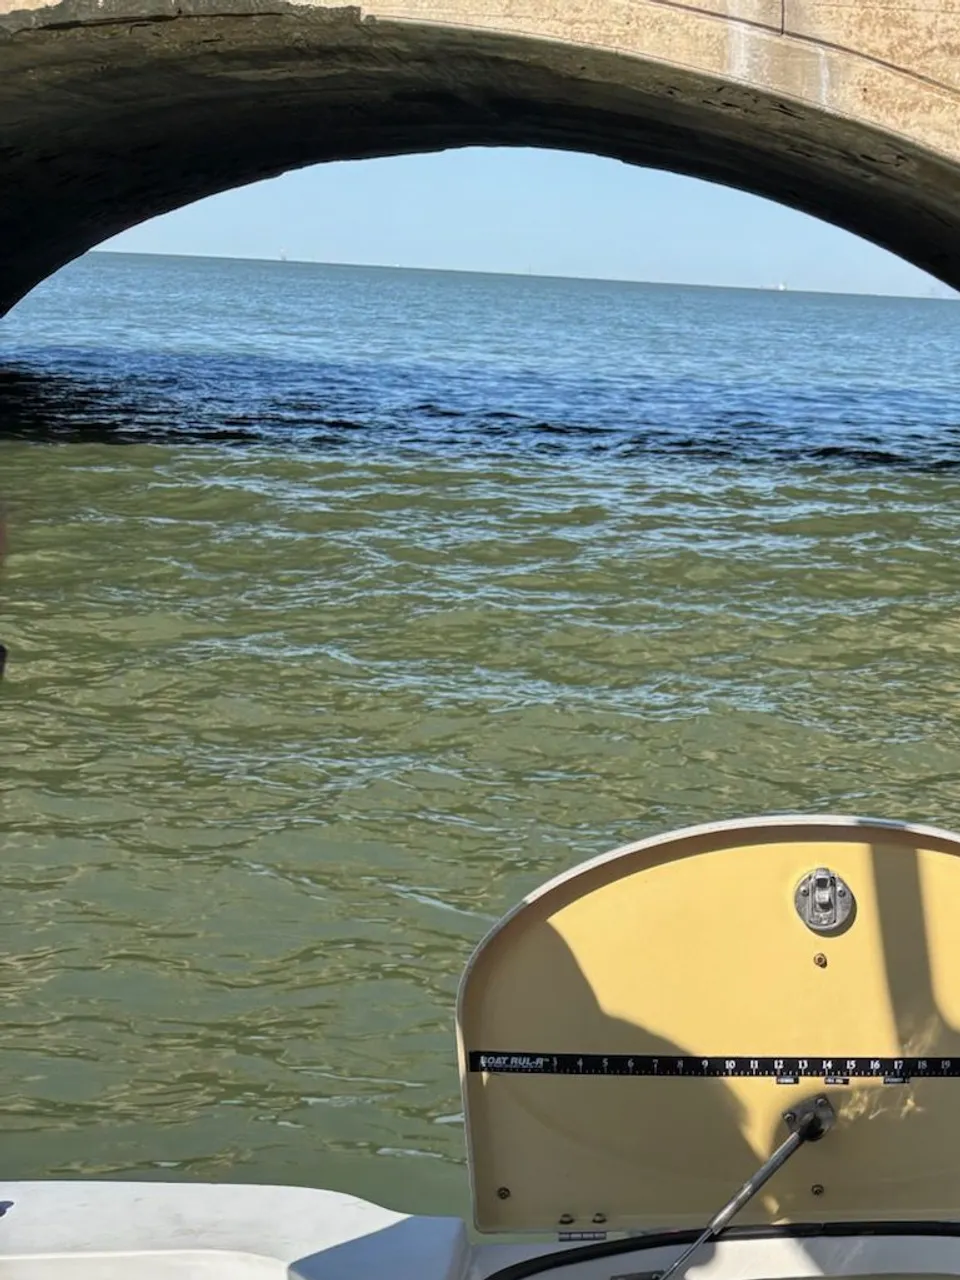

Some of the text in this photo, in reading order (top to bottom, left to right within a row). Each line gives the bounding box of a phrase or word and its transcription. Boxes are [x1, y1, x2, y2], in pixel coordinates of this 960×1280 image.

[576, 1057, 584, 1066] 4
[602, 1058, 609, 1067] 5
[627, 1058, 635, 1067] 6
[652, 1059, 659, 1068] 7
[701, 1060, 709, 1068] 9
[725, 1060, 736, 1069] 10
[750, 1060, 759, 1069] 11
[774, 1060, 784, 1069] 12
[798, 1060, 808, 1069] 13
[822, 1060, 833, 1069] 14
[846, 1060, 857, 1069] 15
[870, 1060, 881, 1069] 16
[893, 1060, 904, 1069] 17
[917, 1060, 928, 1069] 18
[941, 1060, 951, 1069] 19
